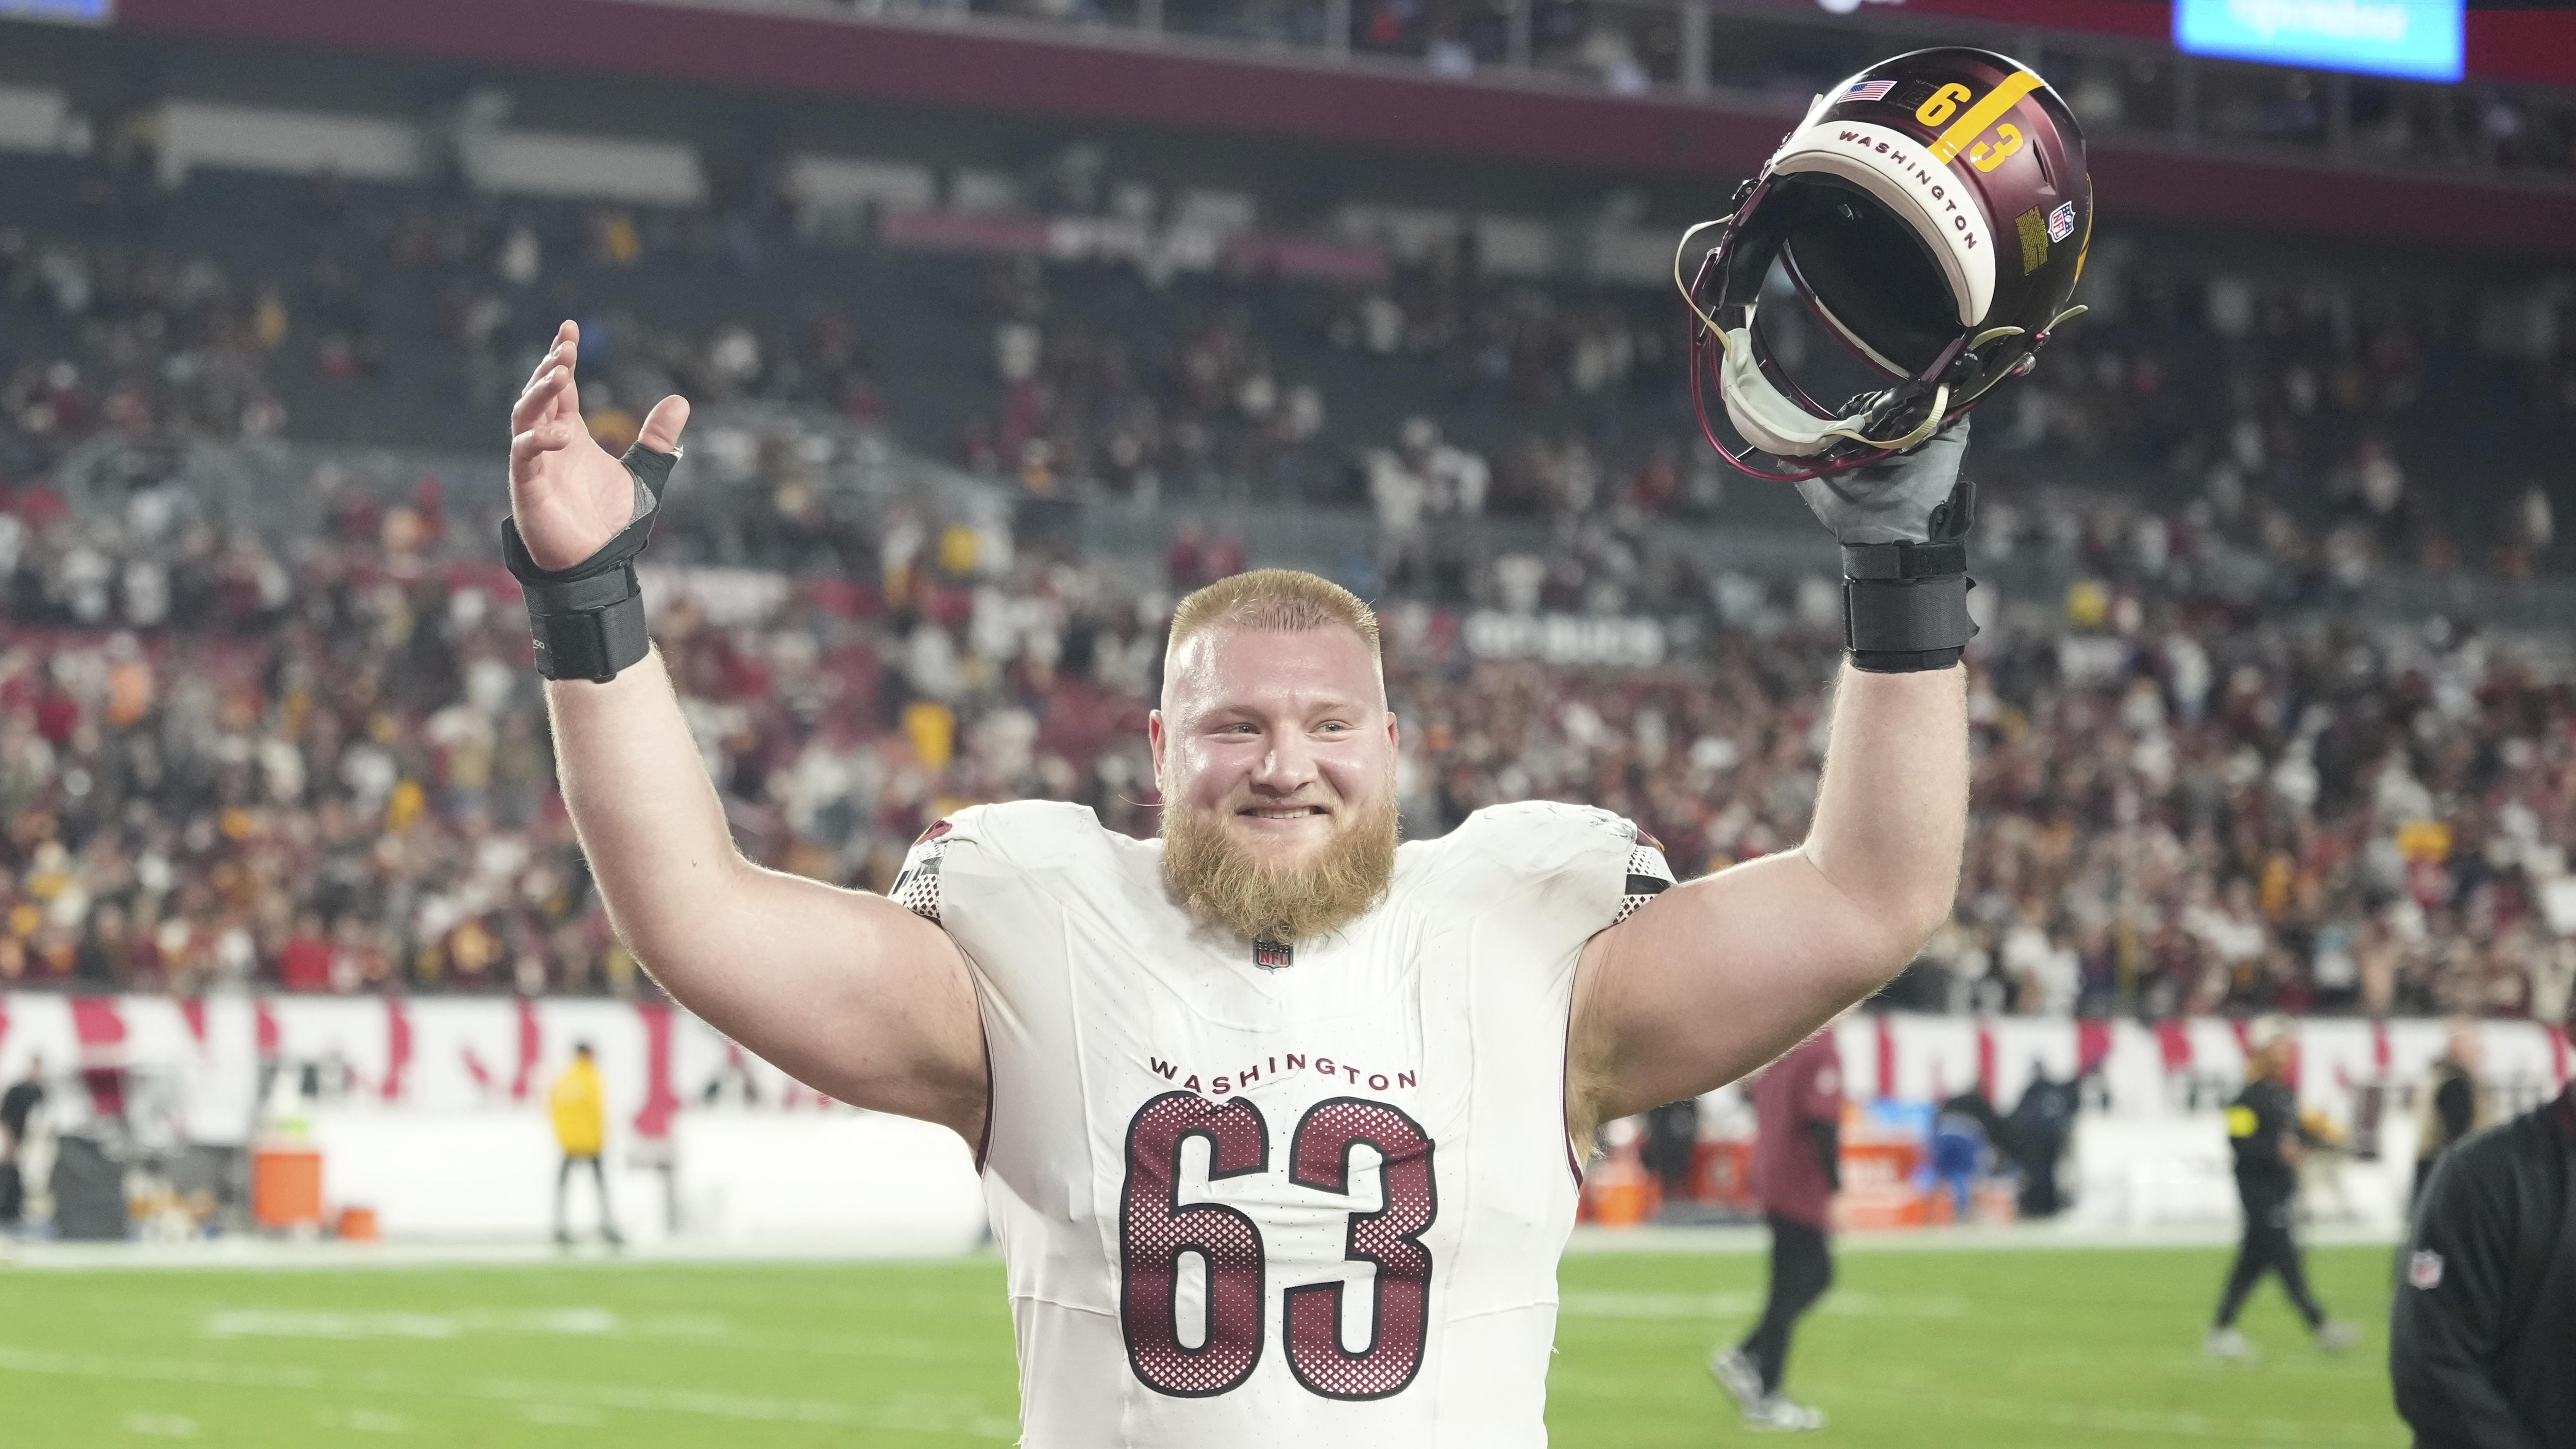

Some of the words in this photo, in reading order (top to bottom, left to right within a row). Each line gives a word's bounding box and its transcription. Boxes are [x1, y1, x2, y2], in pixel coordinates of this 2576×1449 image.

[1839, 130, 1977, 249] WASHINGTON
[2054, 212, 2065, 238] NFL
[1260, 950, 1287, 965] NFL
[1150, 1054, 1417, 1093] WASHINGTON
[1120, 1090, 1437, 1402] 63
